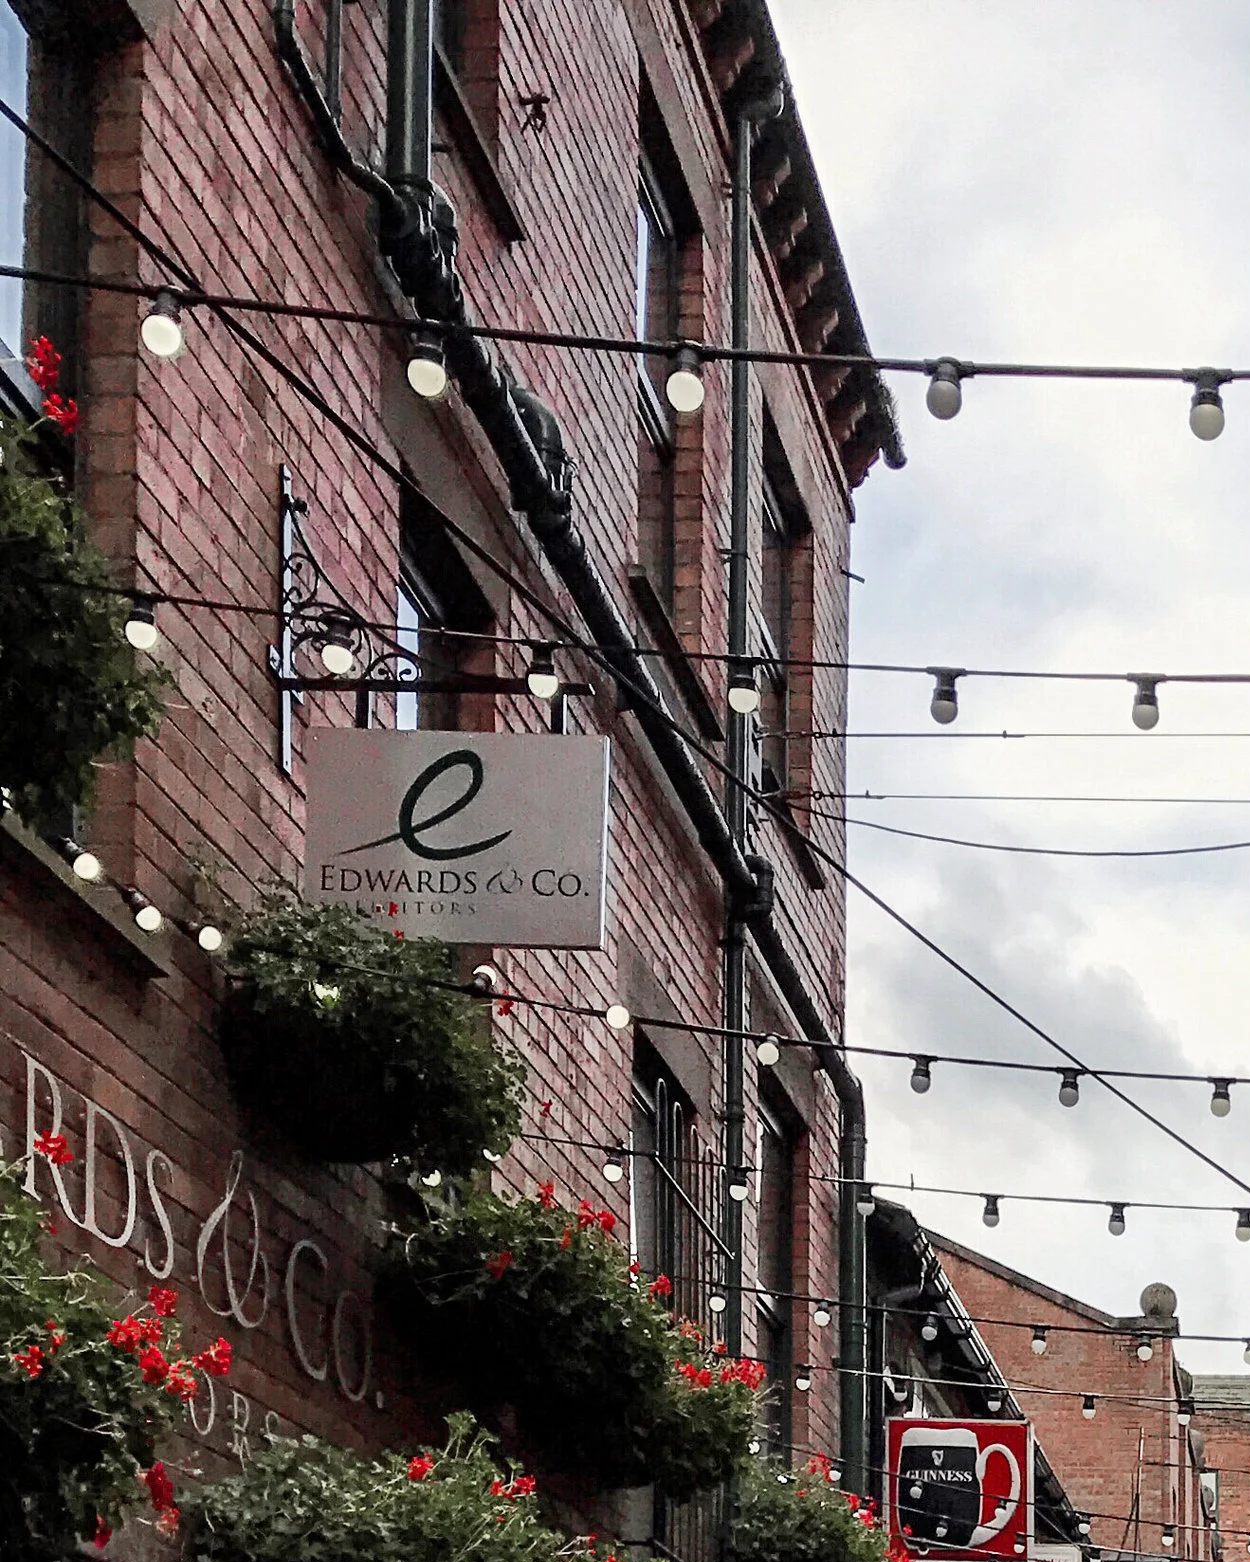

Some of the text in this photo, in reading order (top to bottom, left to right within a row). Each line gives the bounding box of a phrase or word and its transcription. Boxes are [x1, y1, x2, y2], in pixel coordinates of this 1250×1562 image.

[320, 864, 477, 895] EDWARDS
[486, 866, 523, 895] &
[316, 900, 477, 915] LIITORS
[18, 1050, 175, 1280] RDS
[906, 1469, 973, 1482] GUINNESS
